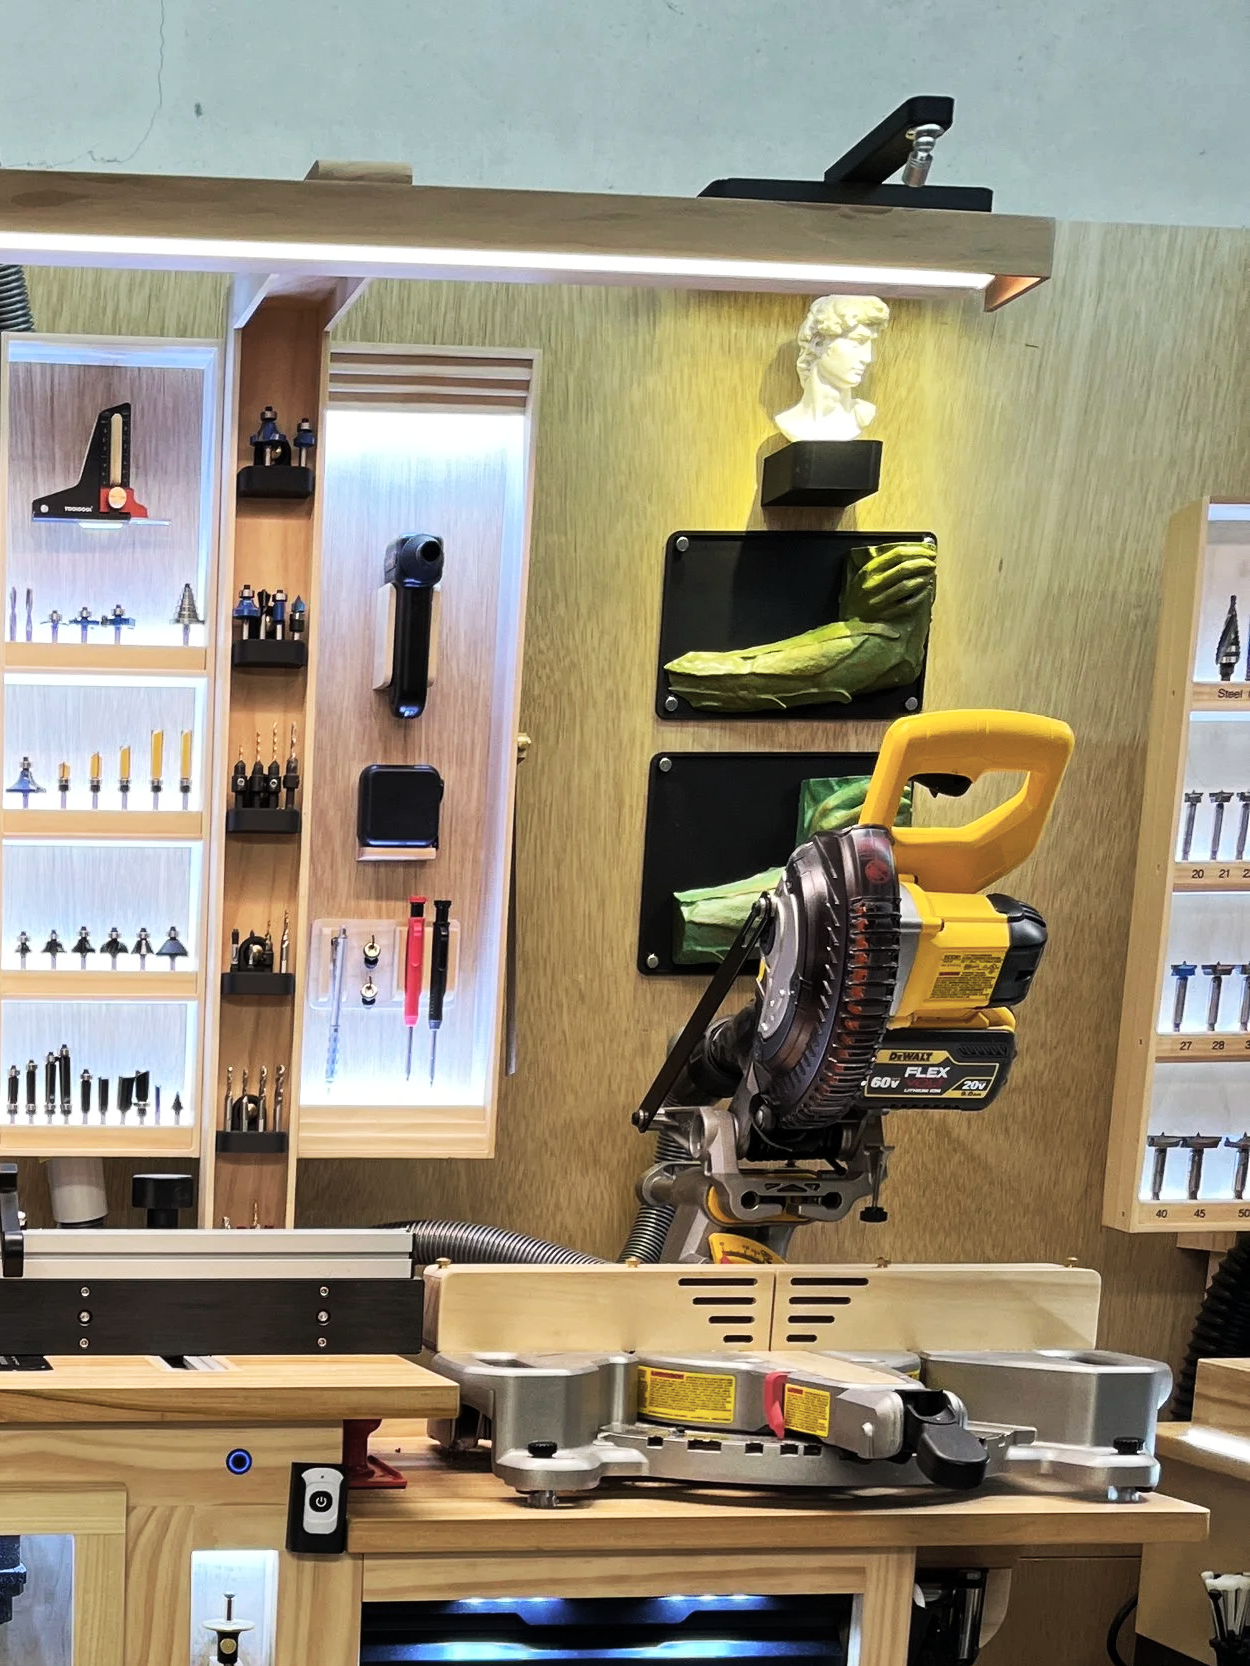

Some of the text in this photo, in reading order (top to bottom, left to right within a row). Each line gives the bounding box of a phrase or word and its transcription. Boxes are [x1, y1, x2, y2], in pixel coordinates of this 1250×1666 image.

[1218, 689, 1243, 699] Steel
[1191, 869, 1250, 879] 20 21 2
[1180, 1041, 1192, 1050] 27
[1212, 1041, 1225, 1050] 28
[905, 1066, 950, 1078] FLEX
[1156, 1209, 1167, 1218] 40
[1194, 1209, 1206, 1218] 45
